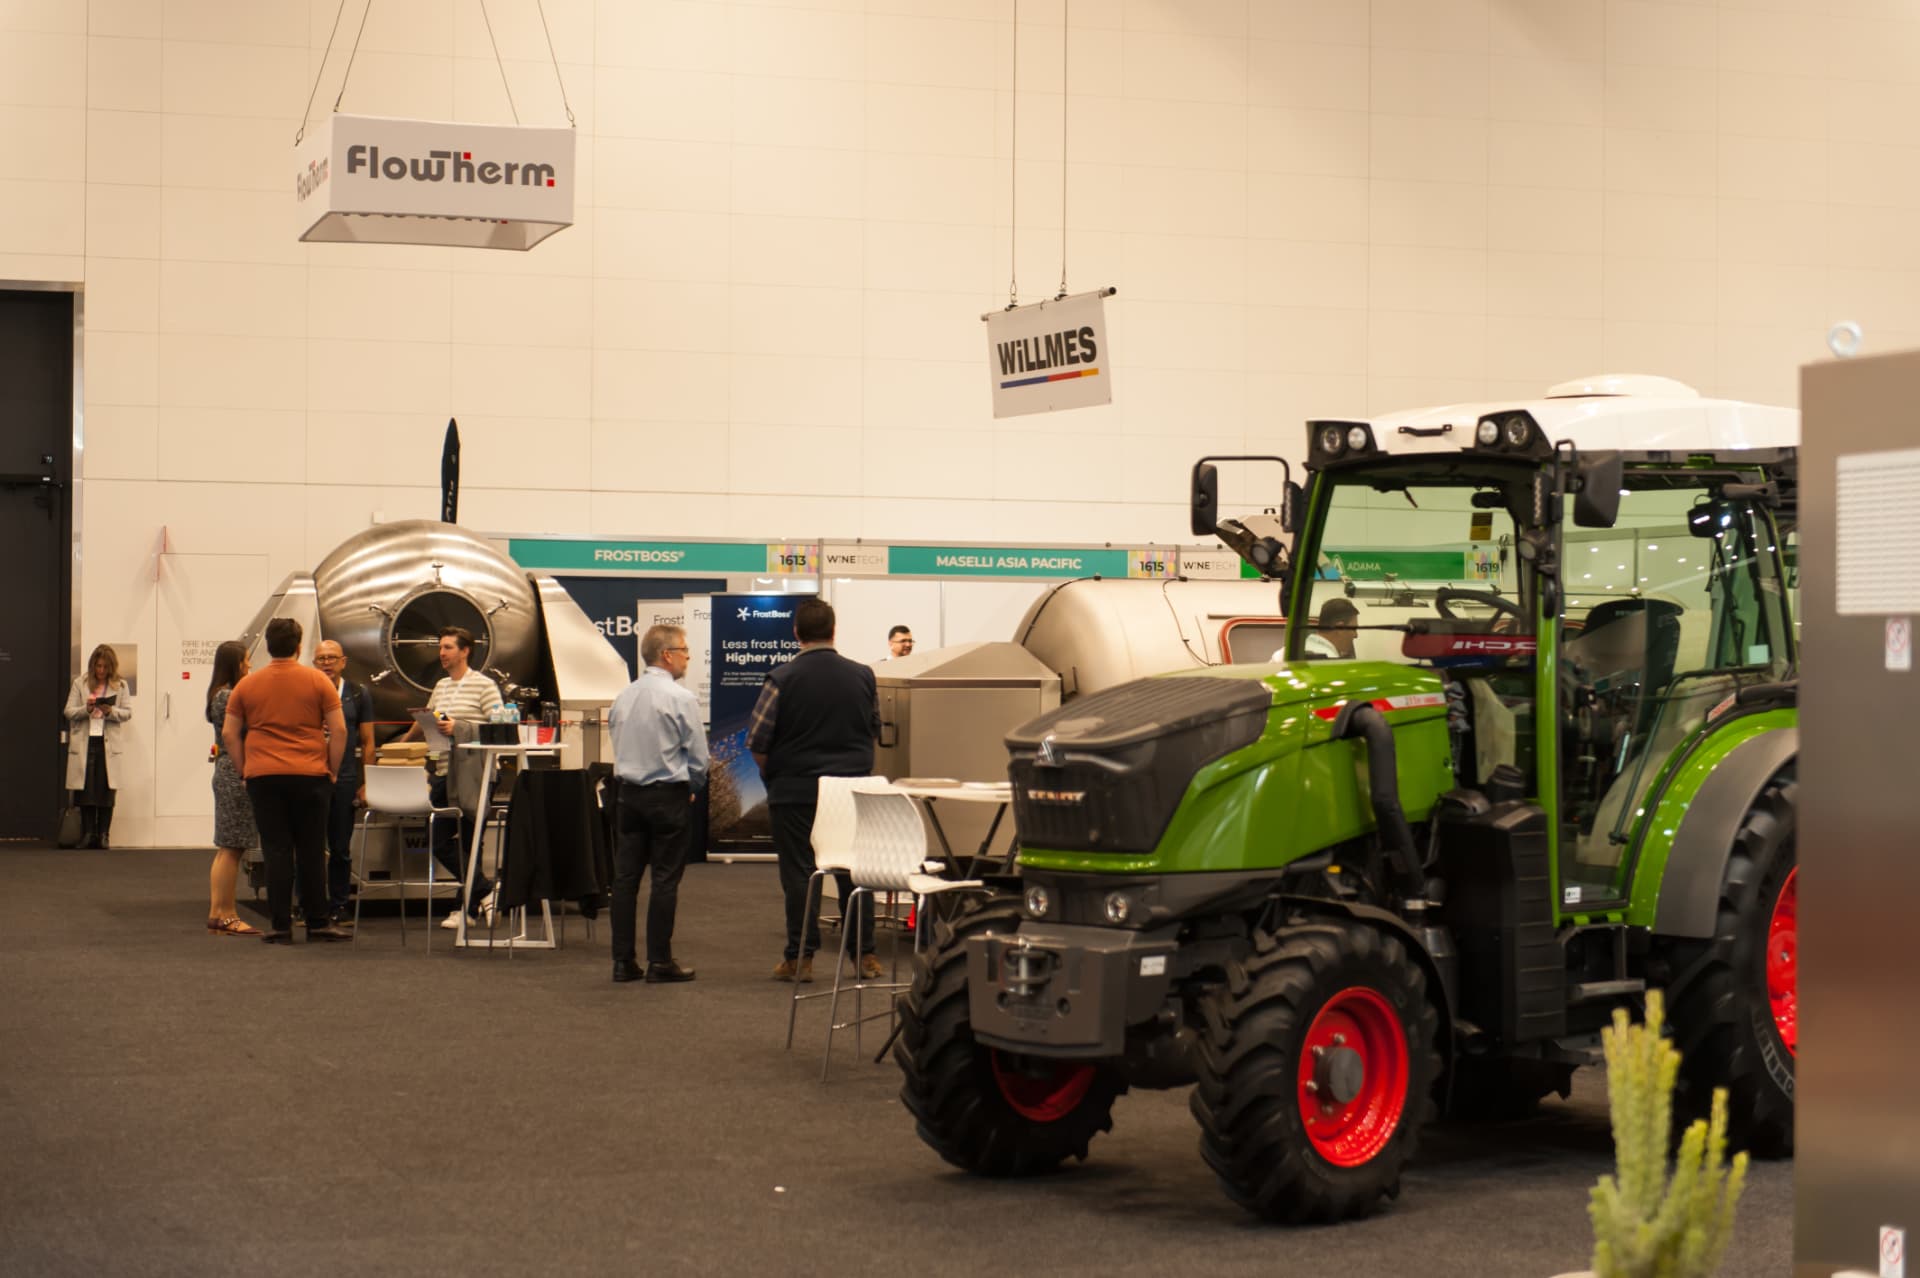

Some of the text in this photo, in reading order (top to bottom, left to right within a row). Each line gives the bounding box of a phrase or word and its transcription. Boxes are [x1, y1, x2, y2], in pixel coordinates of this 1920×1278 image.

[780, 554, 806, 566] 1613
[936, 554, 1082, 571] MASELLI ASIA PACIFIC
[1140, 561, 1165, 572] 1615
[1347, 562, 1381, 572] ADAMA
[1475, 562, 1499, 573] 1619
[722, 639, 748, 649] Less
[750, 639, 778, 649] frost
[725, 651, 767, 666] Higher
